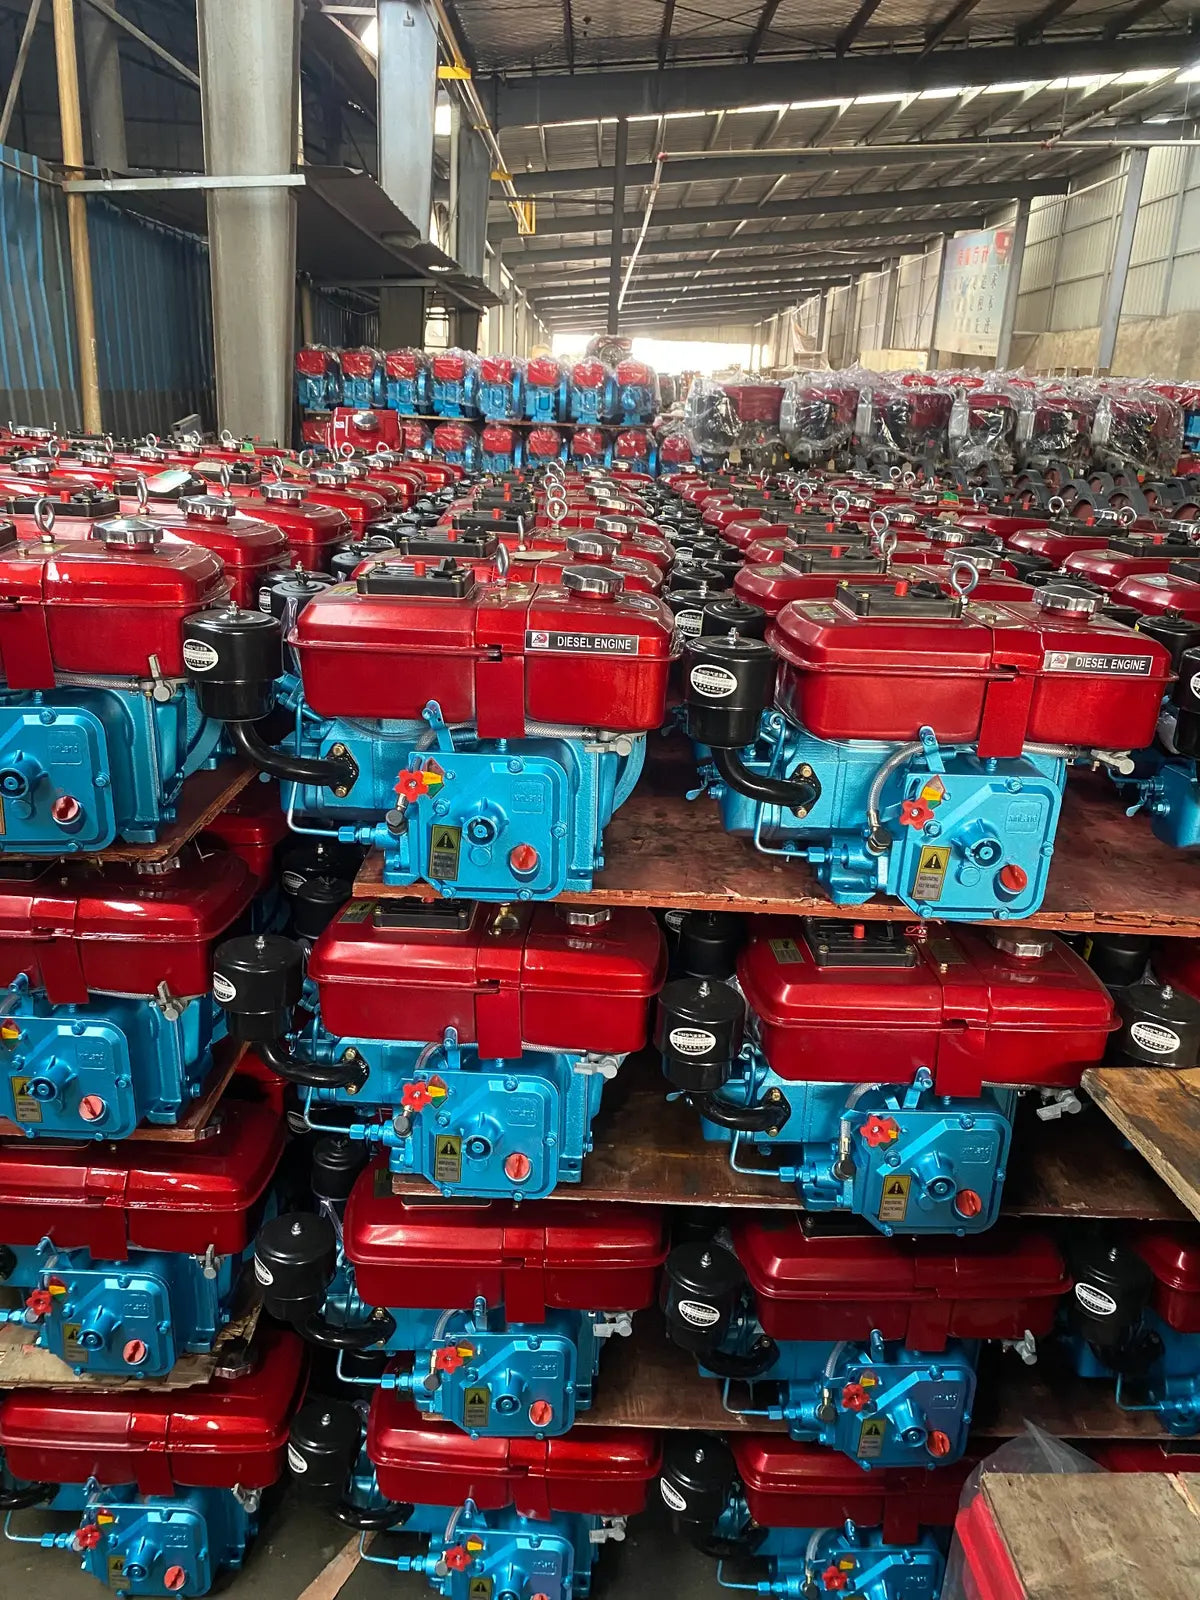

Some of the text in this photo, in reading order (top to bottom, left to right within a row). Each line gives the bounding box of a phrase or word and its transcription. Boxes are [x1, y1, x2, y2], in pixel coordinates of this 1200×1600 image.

[557, 636, 631, 650] DIESEL ENGINE
[1075, 656, 1146, 671] DIESEL ENGINE
